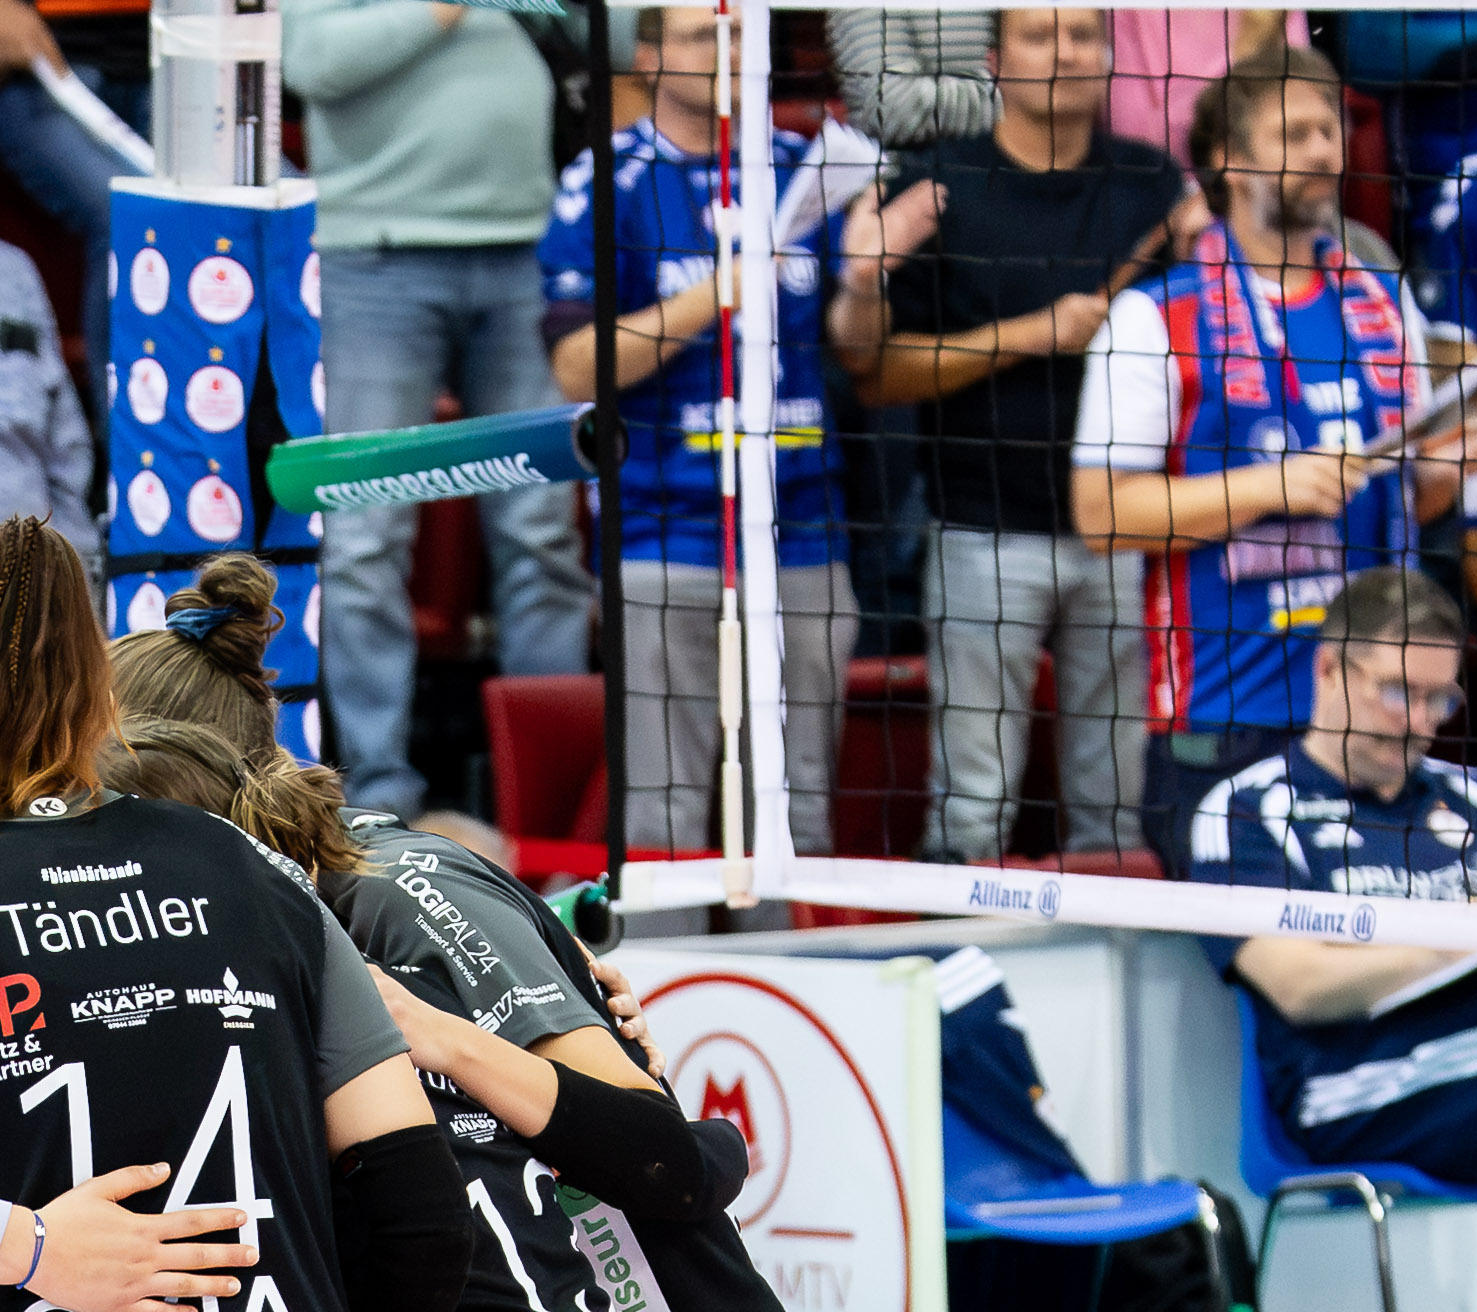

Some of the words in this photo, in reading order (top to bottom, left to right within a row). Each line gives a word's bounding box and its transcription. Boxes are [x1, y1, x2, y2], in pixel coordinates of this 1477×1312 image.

[969, 879, 1033, 912] Allianz
[394, 868, 501, 975] LOGIPAL24
[1278, 903, 1347, 934] Allianz
[414, 912, 449, 950] Transport
[452, 954, 479, 988] Service
[70, 988, 176, 1019] KNAPP
[86, 983, 156, 999] AUTOHAUS
[185, 988, 277, 1010] HOFMANN
[23, 1034, 42, 1054] &
[449, 1119, 497, 1135] KNAPP
